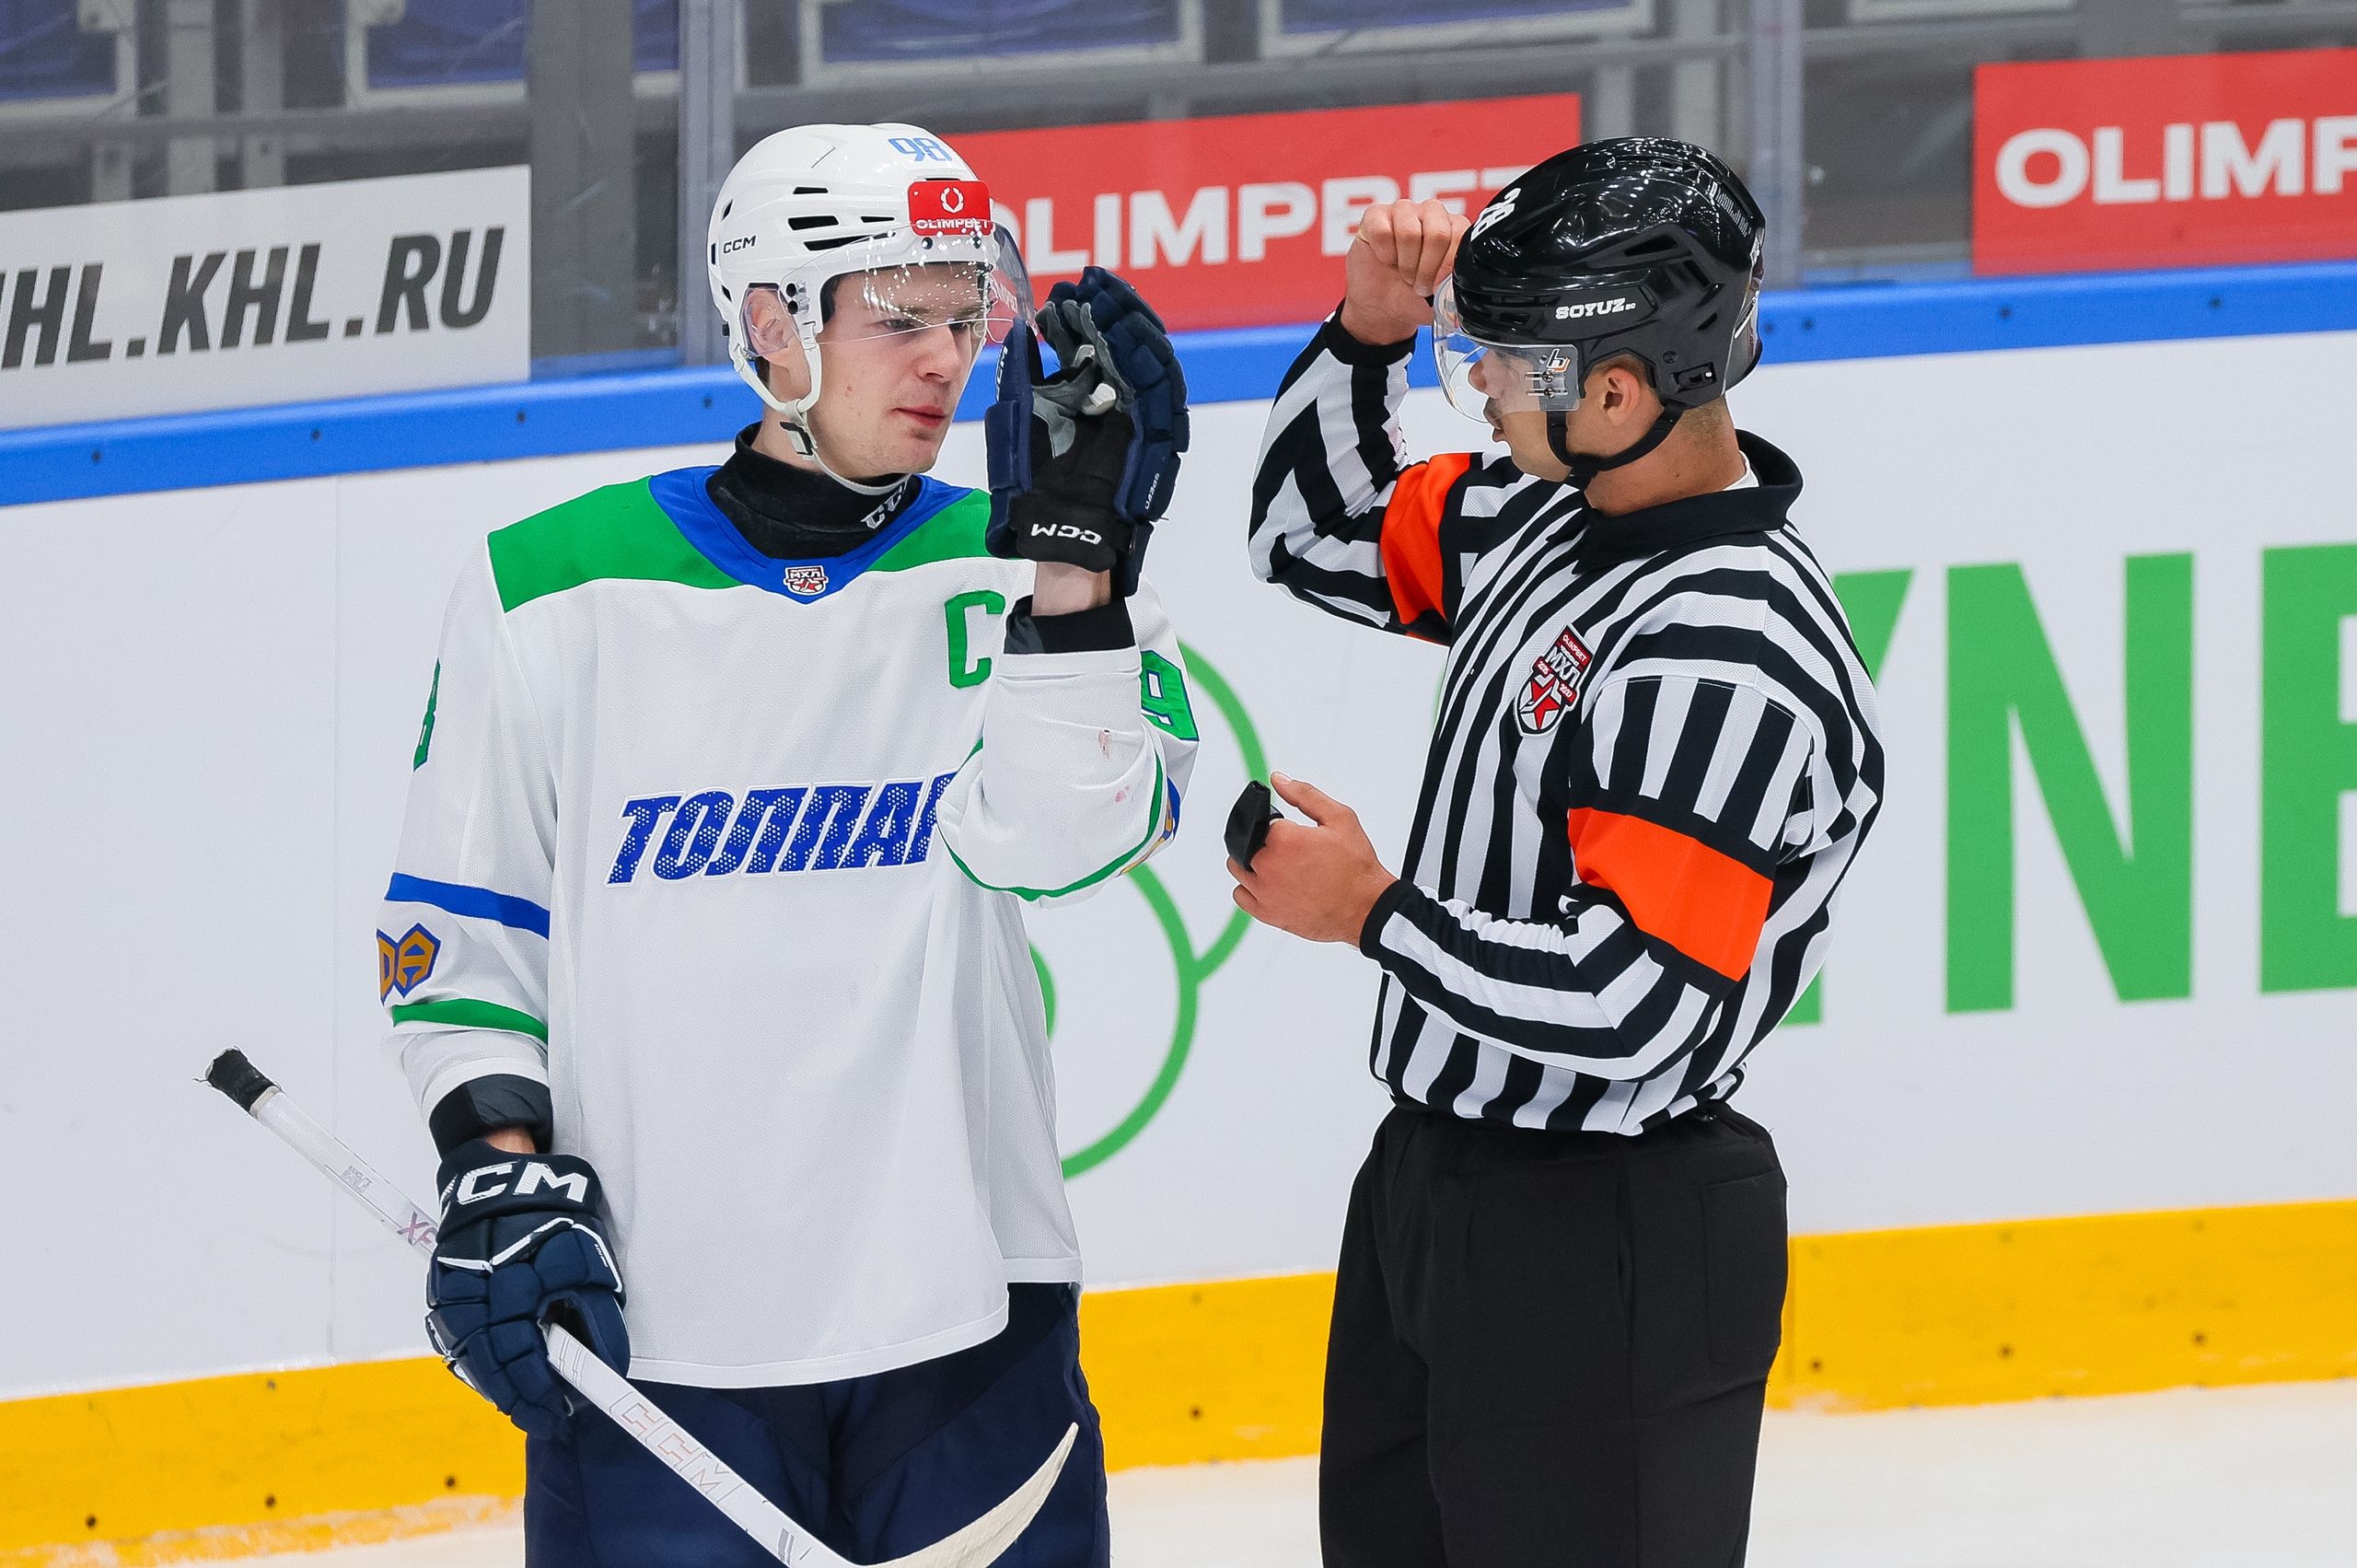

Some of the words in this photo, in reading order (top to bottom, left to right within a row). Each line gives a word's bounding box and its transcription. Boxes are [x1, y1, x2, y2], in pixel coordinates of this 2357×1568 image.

[915, 218, 989, 230] OLIMPBET
[992, 164, 1536, 276] LIMPBE
[723, 235, 757, 254] CCM
[0, 226, 505, 369] HL.KHL.RU
[1555, 297, 1626, 319] SOYUZ
[859, 481, 908, 529] CC
[1030, 523, 1102, 545] CCM
[944, 589, 1005, 690] C
[1544, 645, 1581, 689] МХЛ
